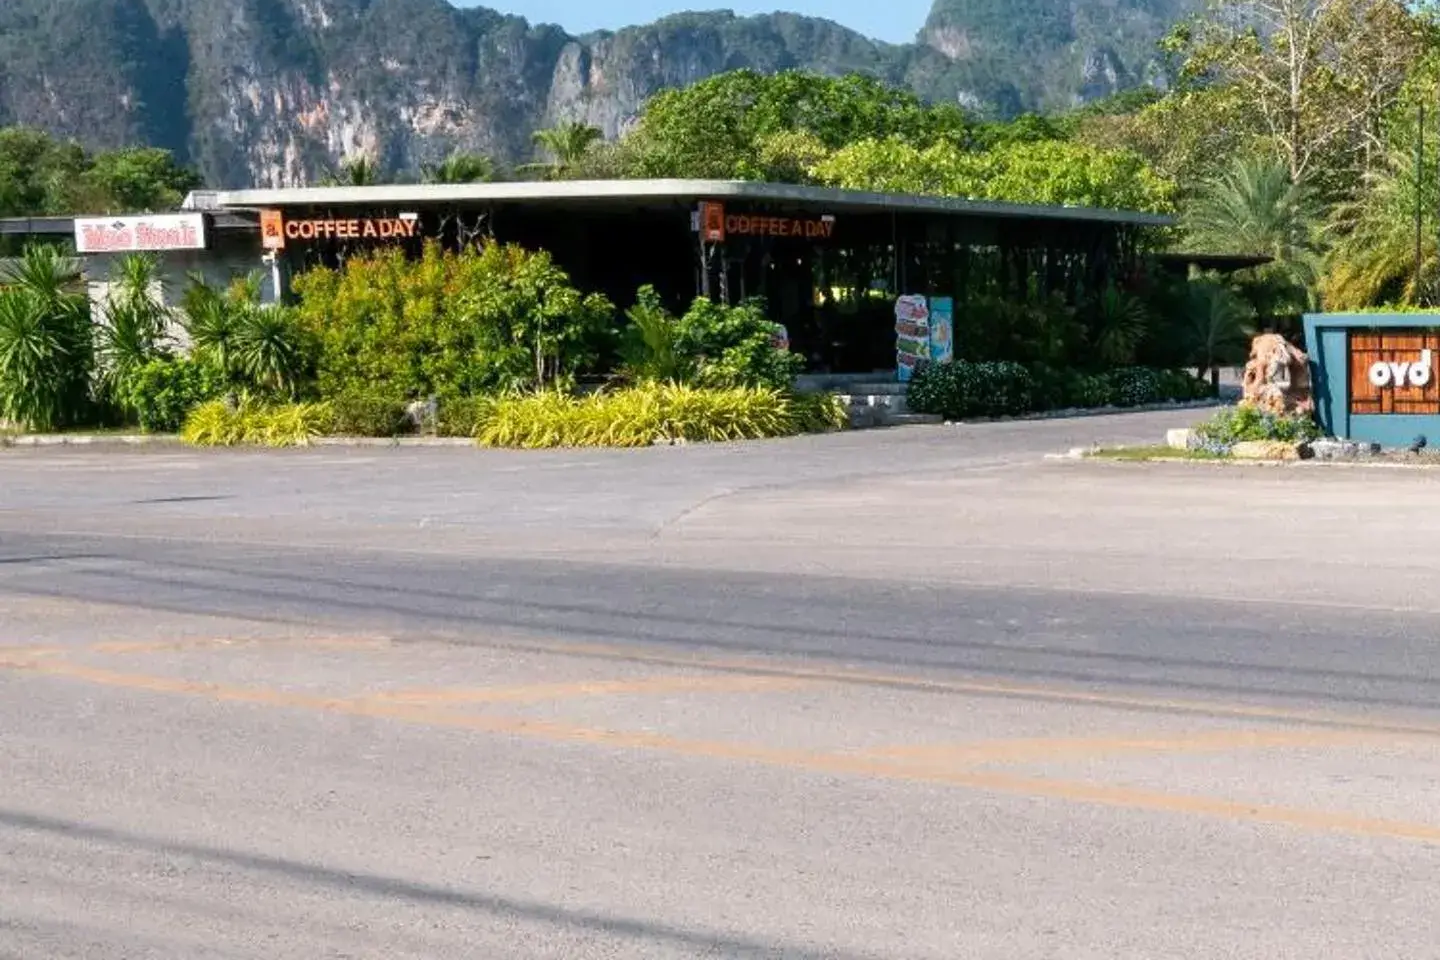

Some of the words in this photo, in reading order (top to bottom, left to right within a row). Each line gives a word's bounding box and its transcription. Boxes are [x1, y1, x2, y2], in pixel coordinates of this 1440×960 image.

[285, 220, 359, 238] COFFEE
[363, 220, 377, 237] A
[380, 219, 416, 238] DAY
[725, 215, 789, 236] COFFEE
[791, 219, 802, 236] A
[805, 219, 833, 237] DAY
